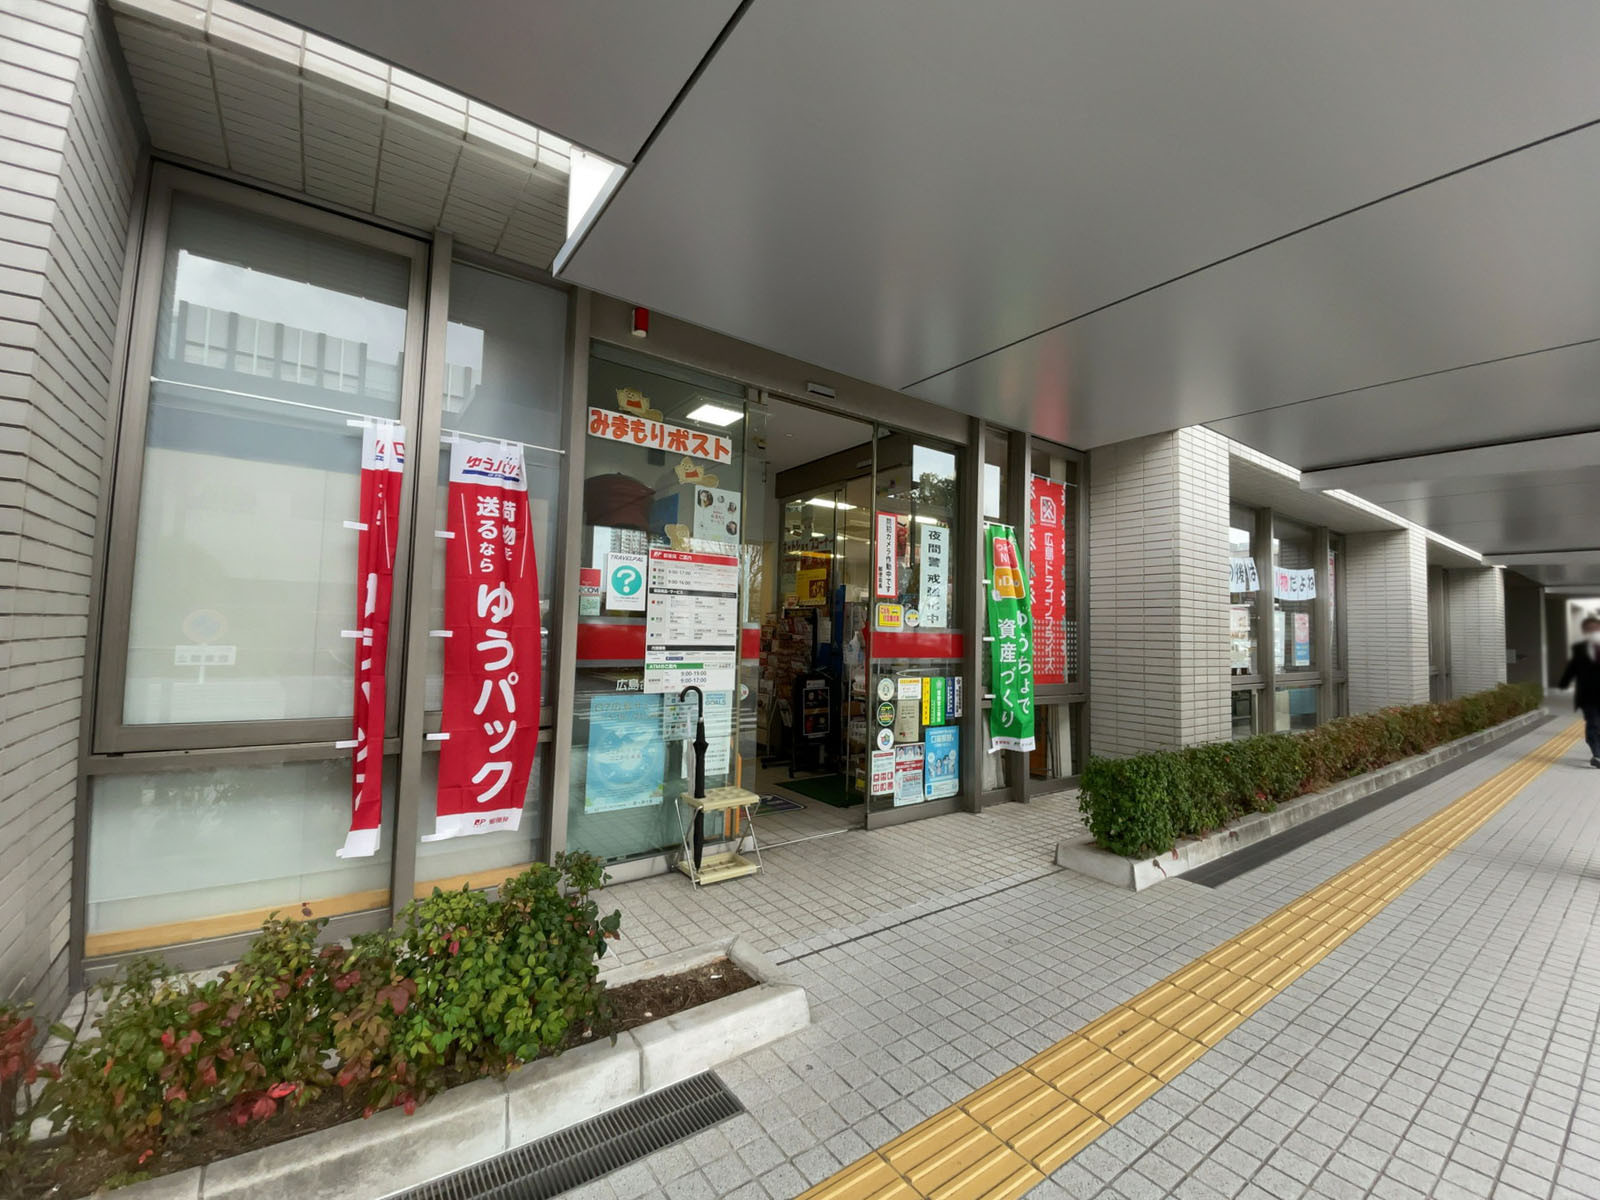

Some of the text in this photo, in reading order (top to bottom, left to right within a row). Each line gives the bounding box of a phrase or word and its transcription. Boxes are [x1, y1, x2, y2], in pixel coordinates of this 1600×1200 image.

[590, 410, 730, 460] みまもりポスト
[476, 496, 500, 573] 送るなら
[471, 580, 519, 803] ゆうパック
[997, 618, 1017, 728] 資産づくり
[1016, 607, 1032, 714] ゆうちょで
